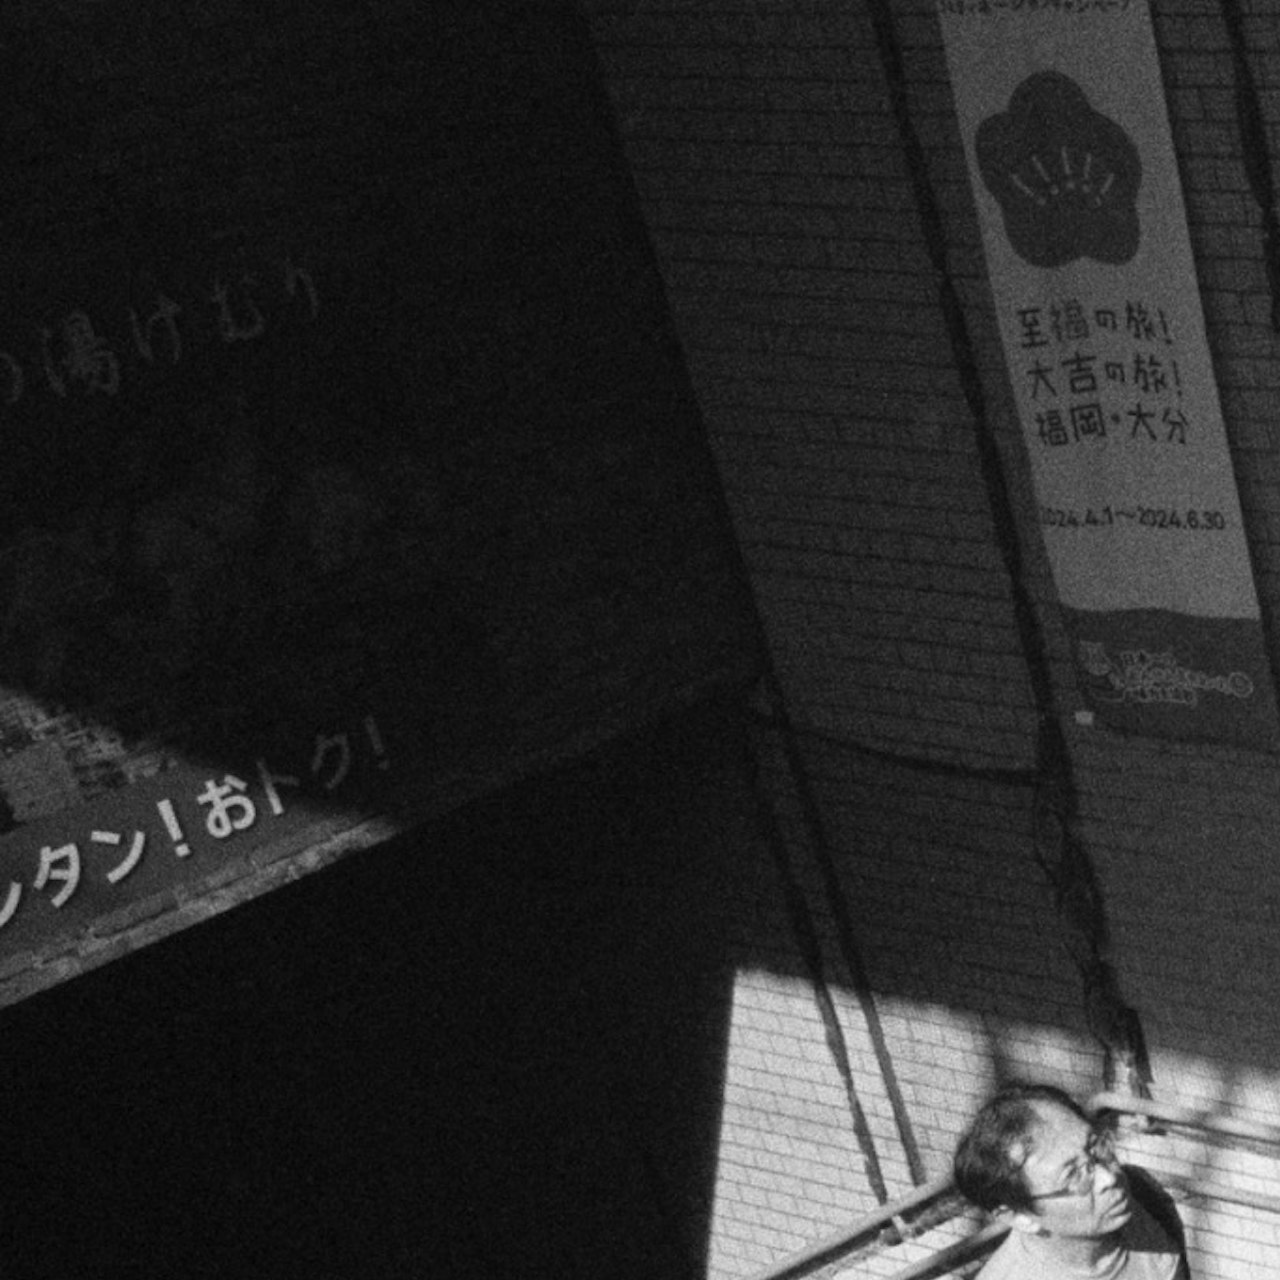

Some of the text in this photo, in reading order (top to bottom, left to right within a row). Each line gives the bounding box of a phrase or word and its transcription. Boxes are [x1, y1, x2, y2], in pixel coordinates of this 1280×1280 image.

[1017, 298, 1173, 348] 至福の旅!
[1026, 353, 1183, 399] 大吉の旅!
